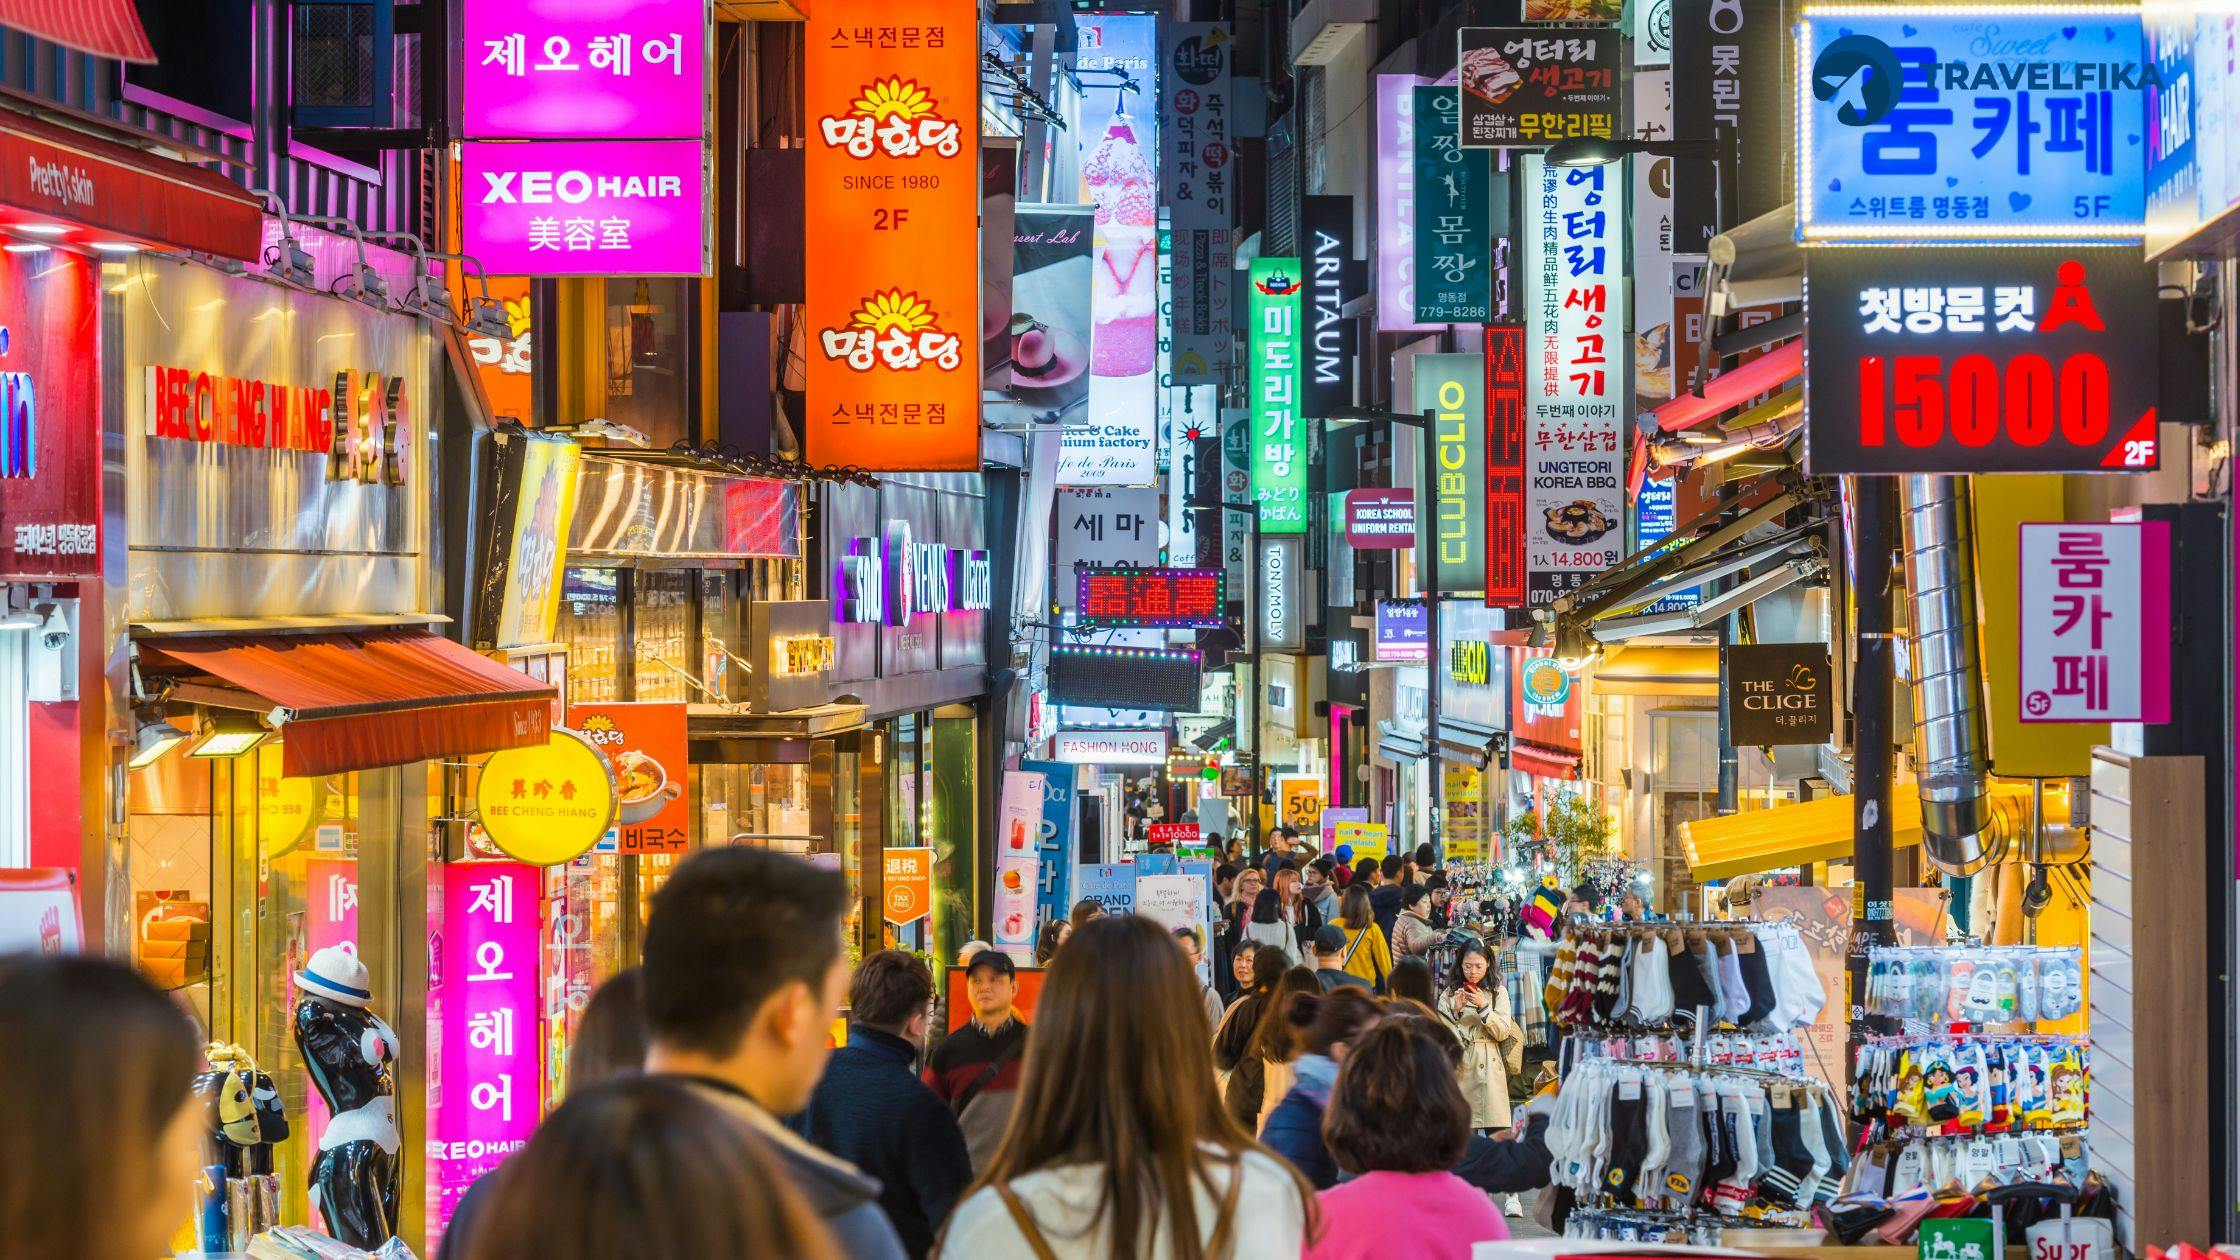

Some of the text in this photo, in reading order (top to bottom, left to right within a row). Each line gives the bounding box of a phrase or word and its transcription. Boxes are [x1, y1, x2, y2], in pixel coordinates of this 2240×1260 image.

[831, 27, 944, 48] 스낵전문점
[481, 33, 682, 76] 제오헤어
[1504, 38, 1596, 68] 엉터리
[1529, 65, 1612, 97] 생고기
[820, 114, 960, 158] 명화당
[1520, 112, 1612, 140] 무한리필
[482, 171, 682, 203] XEO HAIR
[843, 175, 940, 189] SINCE 1980
[1849, 196, 2111, 219] 스위트룸 명동점 5F
[873, 208, 909, 230] 2F
[1562, 165, 1606, 277] 엉터리
[528, 216, 632, 251] 美容室
[1315, 230, 1341, 384] ARITAUM
[1437, 292, 1467, 303] 명동점
[1420, 307, 1486, 318] 779-8286
[1860, 286, 2035, 334] 첫방문 컷
[821, 326, 961, 371] 명화당
[1564, 284, 1607, 396] 생고기
[1264, 305, 1295, 477] 미도리가방
[1860, 353, 2110, 448] 15000
[155, 365, 190, 438] BEE
[194, 371, 266, 448] CHENG
[271, 384, 332, 454] HIANG
[832, 404, 945, 424] 스낵전문점
[1536, 405, 1616, 418] 두번째 이야기
[1105, 425, 1140, 436] Cake
[1535, 428, 1617, 451] 무한삼겹
[1098, 436, 1151, 449] factory
[2124, 440, 2155, 465] 2F
[1538, 461, 1612, 474] UNGTEORI
[1258, 486, 1299, 501] みどり
[1534, 476, 1617, 490] KOREA BBQ
[1260, 505, 1301, 521] かばん
[1356, 509, 1413, 519] KOREA SCHOOL
[1352, 523, 1387, 533] UNIFORM
[1173, 554, 1195, 562] Coff
[912, 542, 948, 613] VENUS
[1270, 547, 1281, 640] TONYMOLY
[2051, 532, 2112, 711] 룸카페
[1741, 680, 1775, 692] THE
[1743, 693, 1817, 710] CLIGE
[2027, 694, 2050, 714] 5F
[1063, 741, 1117, 753] FASHION
[490, 806, 597, 818] BEE CHENG HIANG
[621, 828, 686, 850] 비국수
[894, 894, 910, 902] TAX
[466, 874, 514, 1122] 제오헤어
